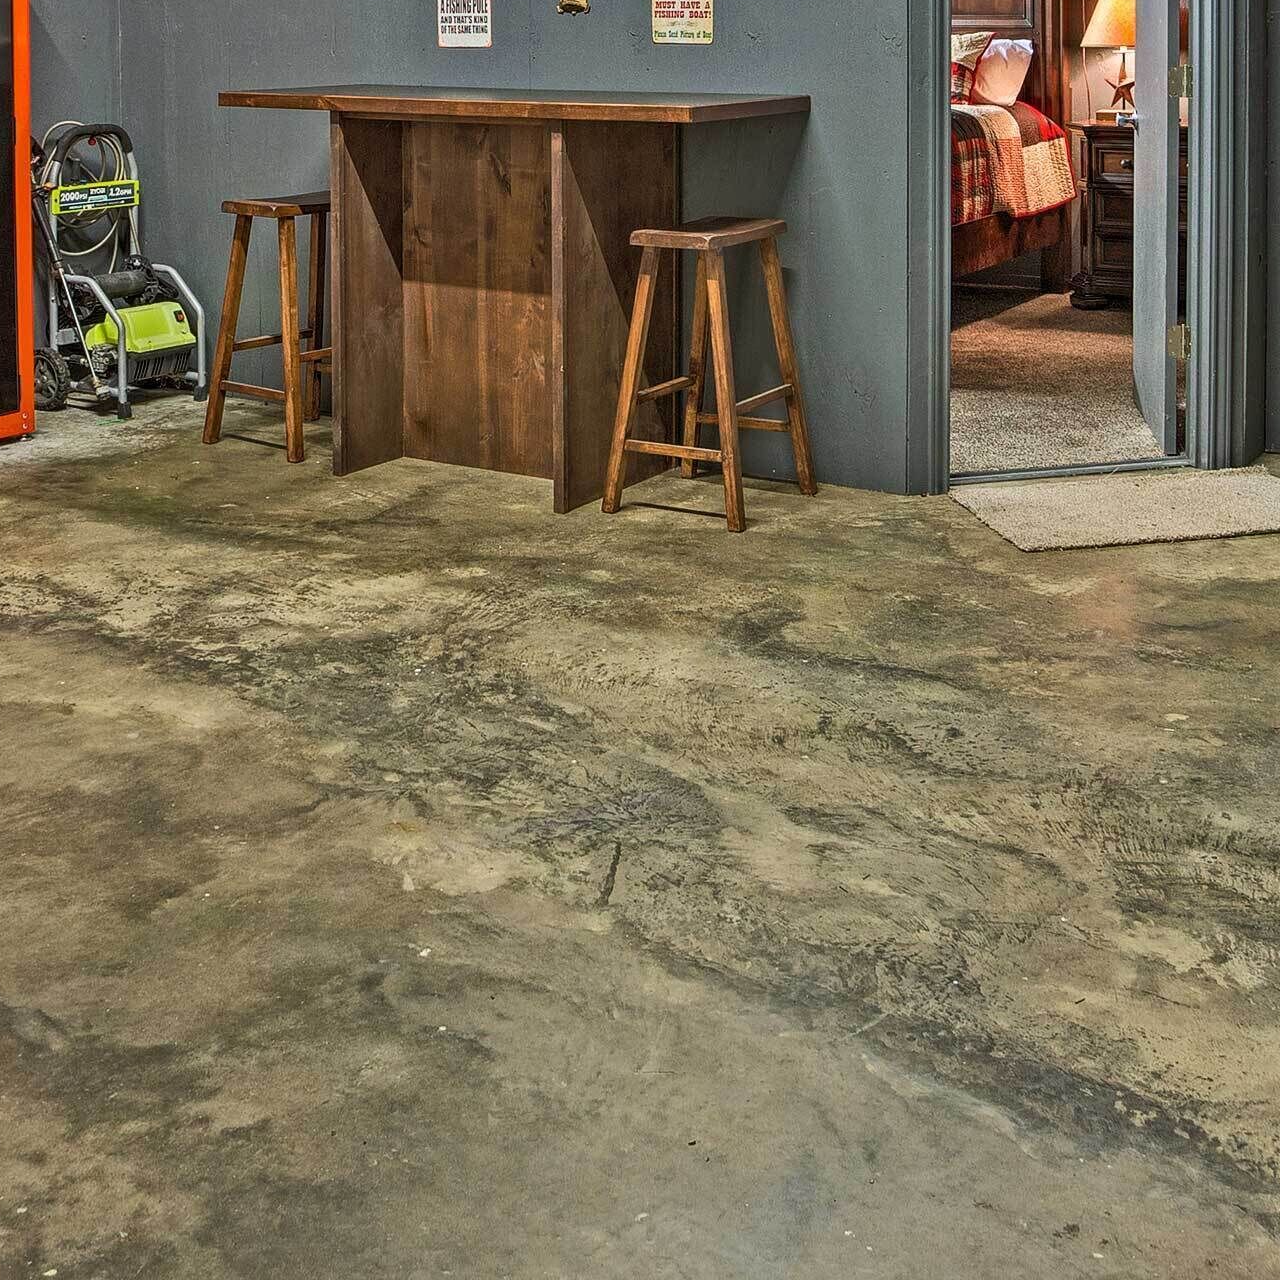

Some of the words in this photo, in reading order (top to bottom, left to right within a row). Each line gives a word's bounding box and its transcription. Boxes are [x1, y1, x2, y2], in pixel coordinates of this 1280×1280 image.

[655, 1, 676, 9] MUST
[680, 1, 701, 9] HAVE
[704, 1, 710, 9] A
[654, 10, 685, 19] FISHING
[689, 10, 712, 19] BOAT!
[440, 16, 452, 24] AND
[453, 16, 473, 24] THAT'S
[474, 16, 488, 24] KIND
[440, 25, 447, 34] OF
[448, 25, 457, 34] THE
[458, 25, 471, 34] SAME
[472, 25, 488, 34] THING
